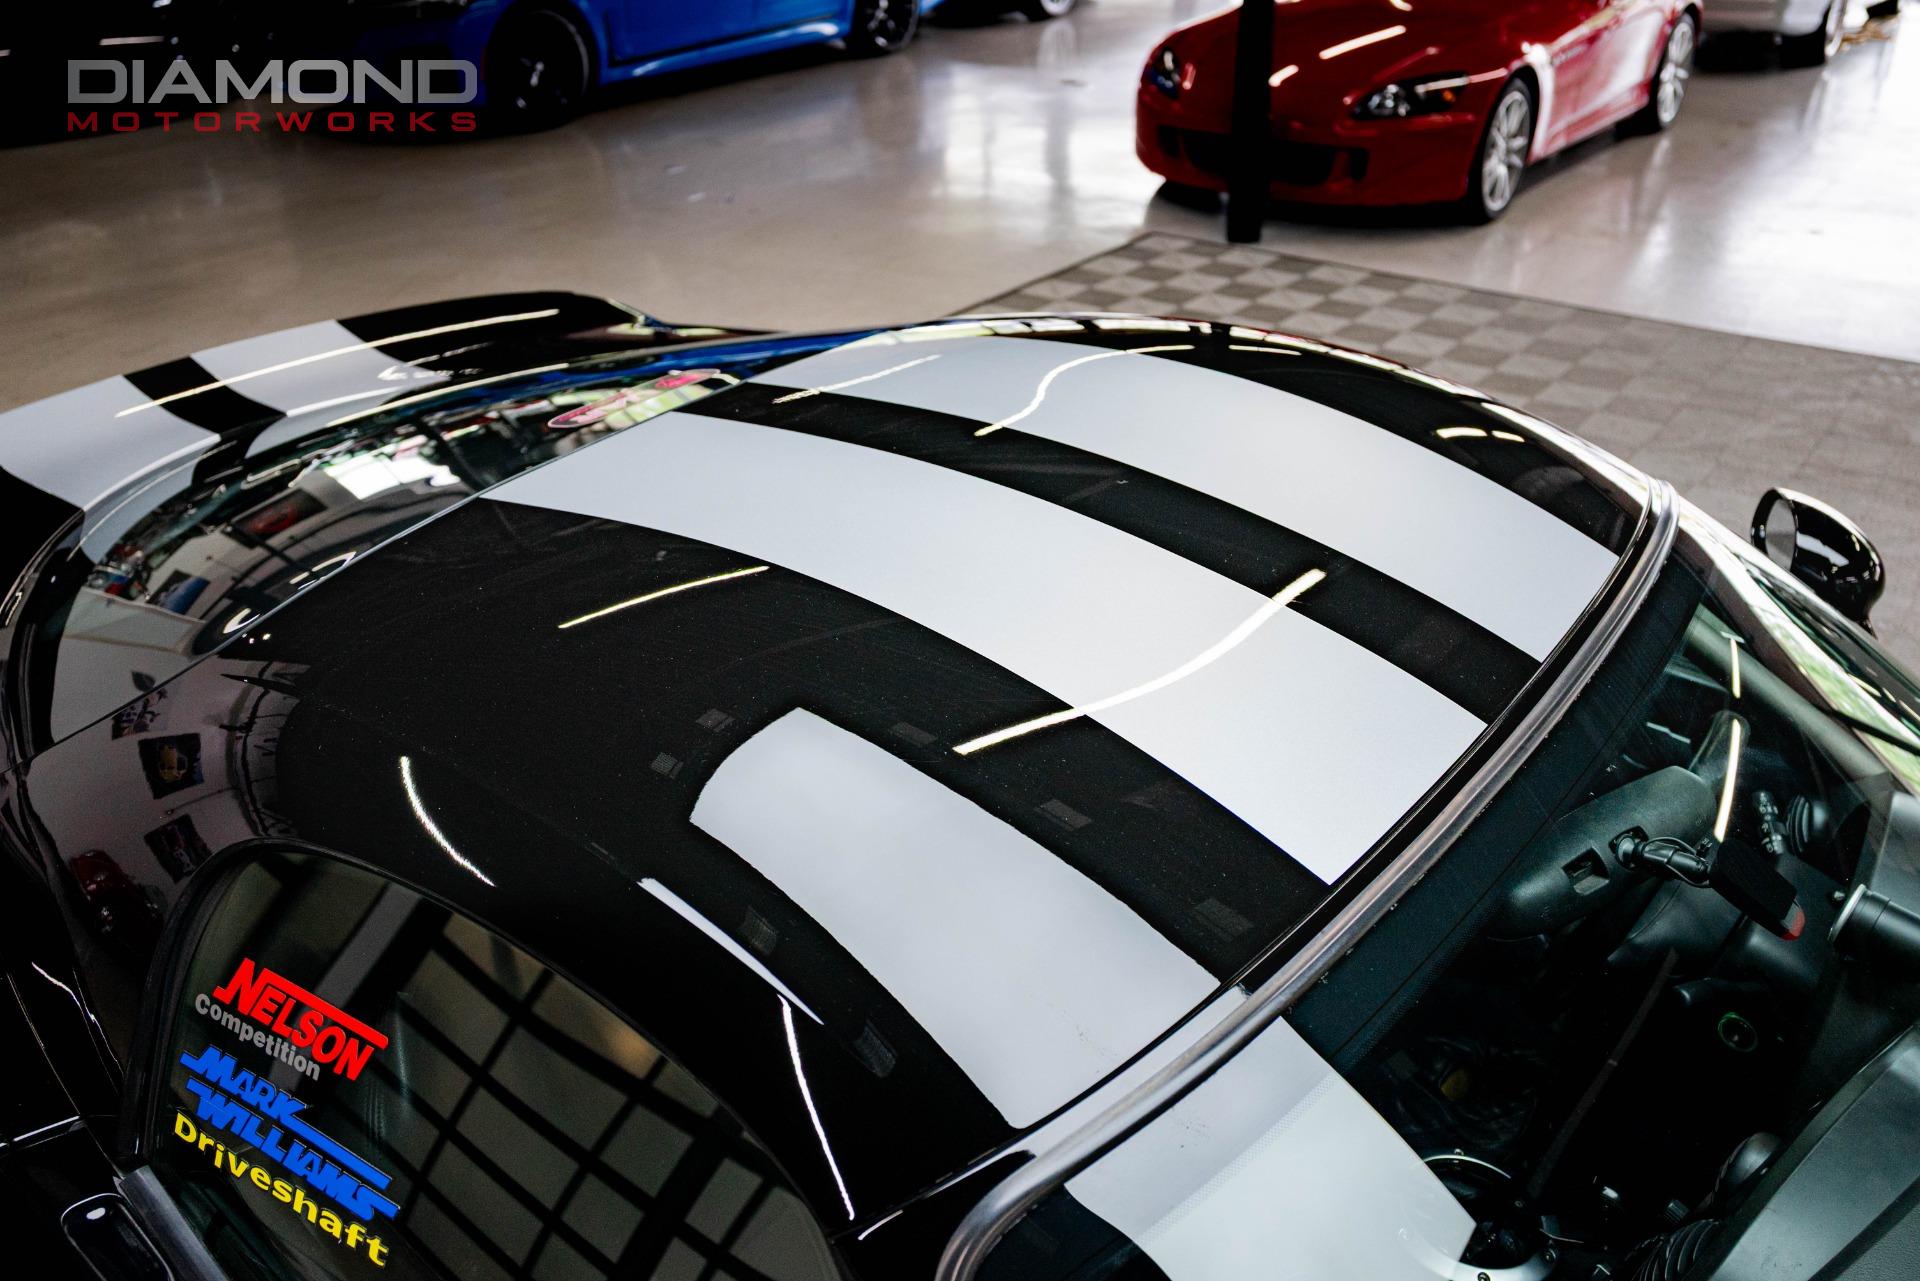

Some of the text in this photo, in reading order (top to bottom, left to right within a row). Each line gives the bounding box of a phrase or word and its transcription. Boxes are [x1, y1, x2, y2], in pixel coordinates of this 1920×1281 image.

[195, 993, 321, 1081] Competition
[212, 957, 389, 1081] NELSON
[173, 1111, 390, 1267] Driveshaft
[179, 1045, 392, 1191] MARK
[185, 1076, 400, 1221] WILLIAMS
